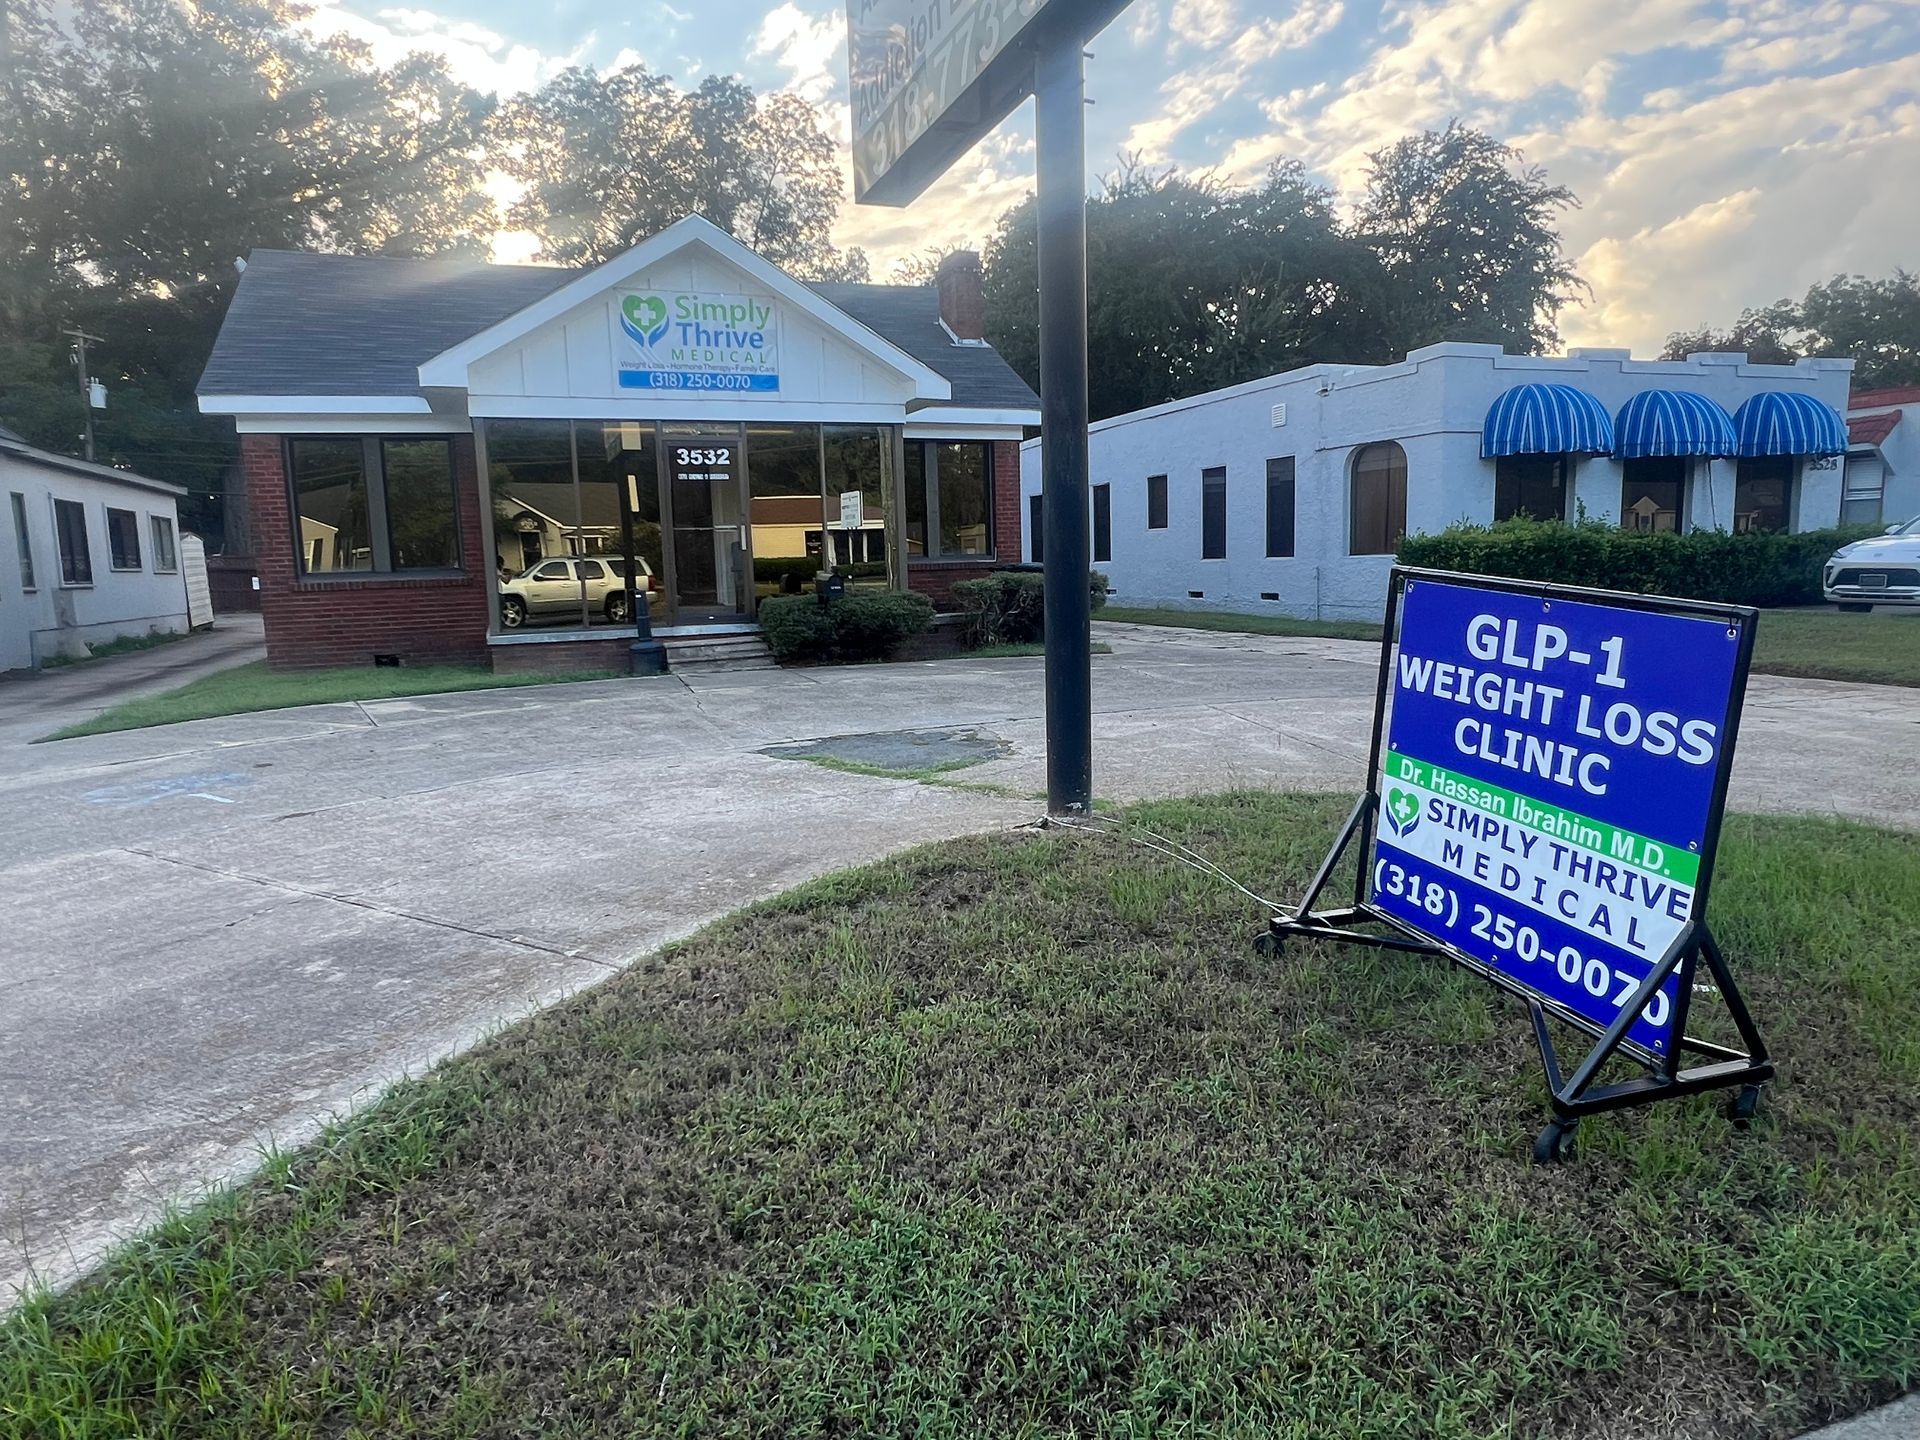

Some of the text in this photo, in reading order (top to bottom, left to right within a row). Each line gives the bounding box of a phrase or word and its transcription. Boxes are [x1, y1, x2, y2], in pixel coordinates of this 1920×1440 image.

[675, 295, 771, 330] Simply
[675, 322, 764, 349] Thrive
[650, 372, 751, 389] (318) 250-0070
[671, 348, 767, 364] MEDICAL
[676, 448, 731, 465] 3532
[1809, 459, 1838, 471] 3528
[1466, 613, 1627, 689] GLP-1
[1400, 653, 1718, 765] WEIGHT LOSS
[1454, 717, 1612, 796] CLINIC
[1400, 758, 1671, 876] Dr. Hassan Ibrahim M.D.
[1373, 858, 1460, 929] (318)
[1427, 797, 1692, 922] SIMPLY THRIVE
[1443, 839, 1647, 951] MEDICAL
